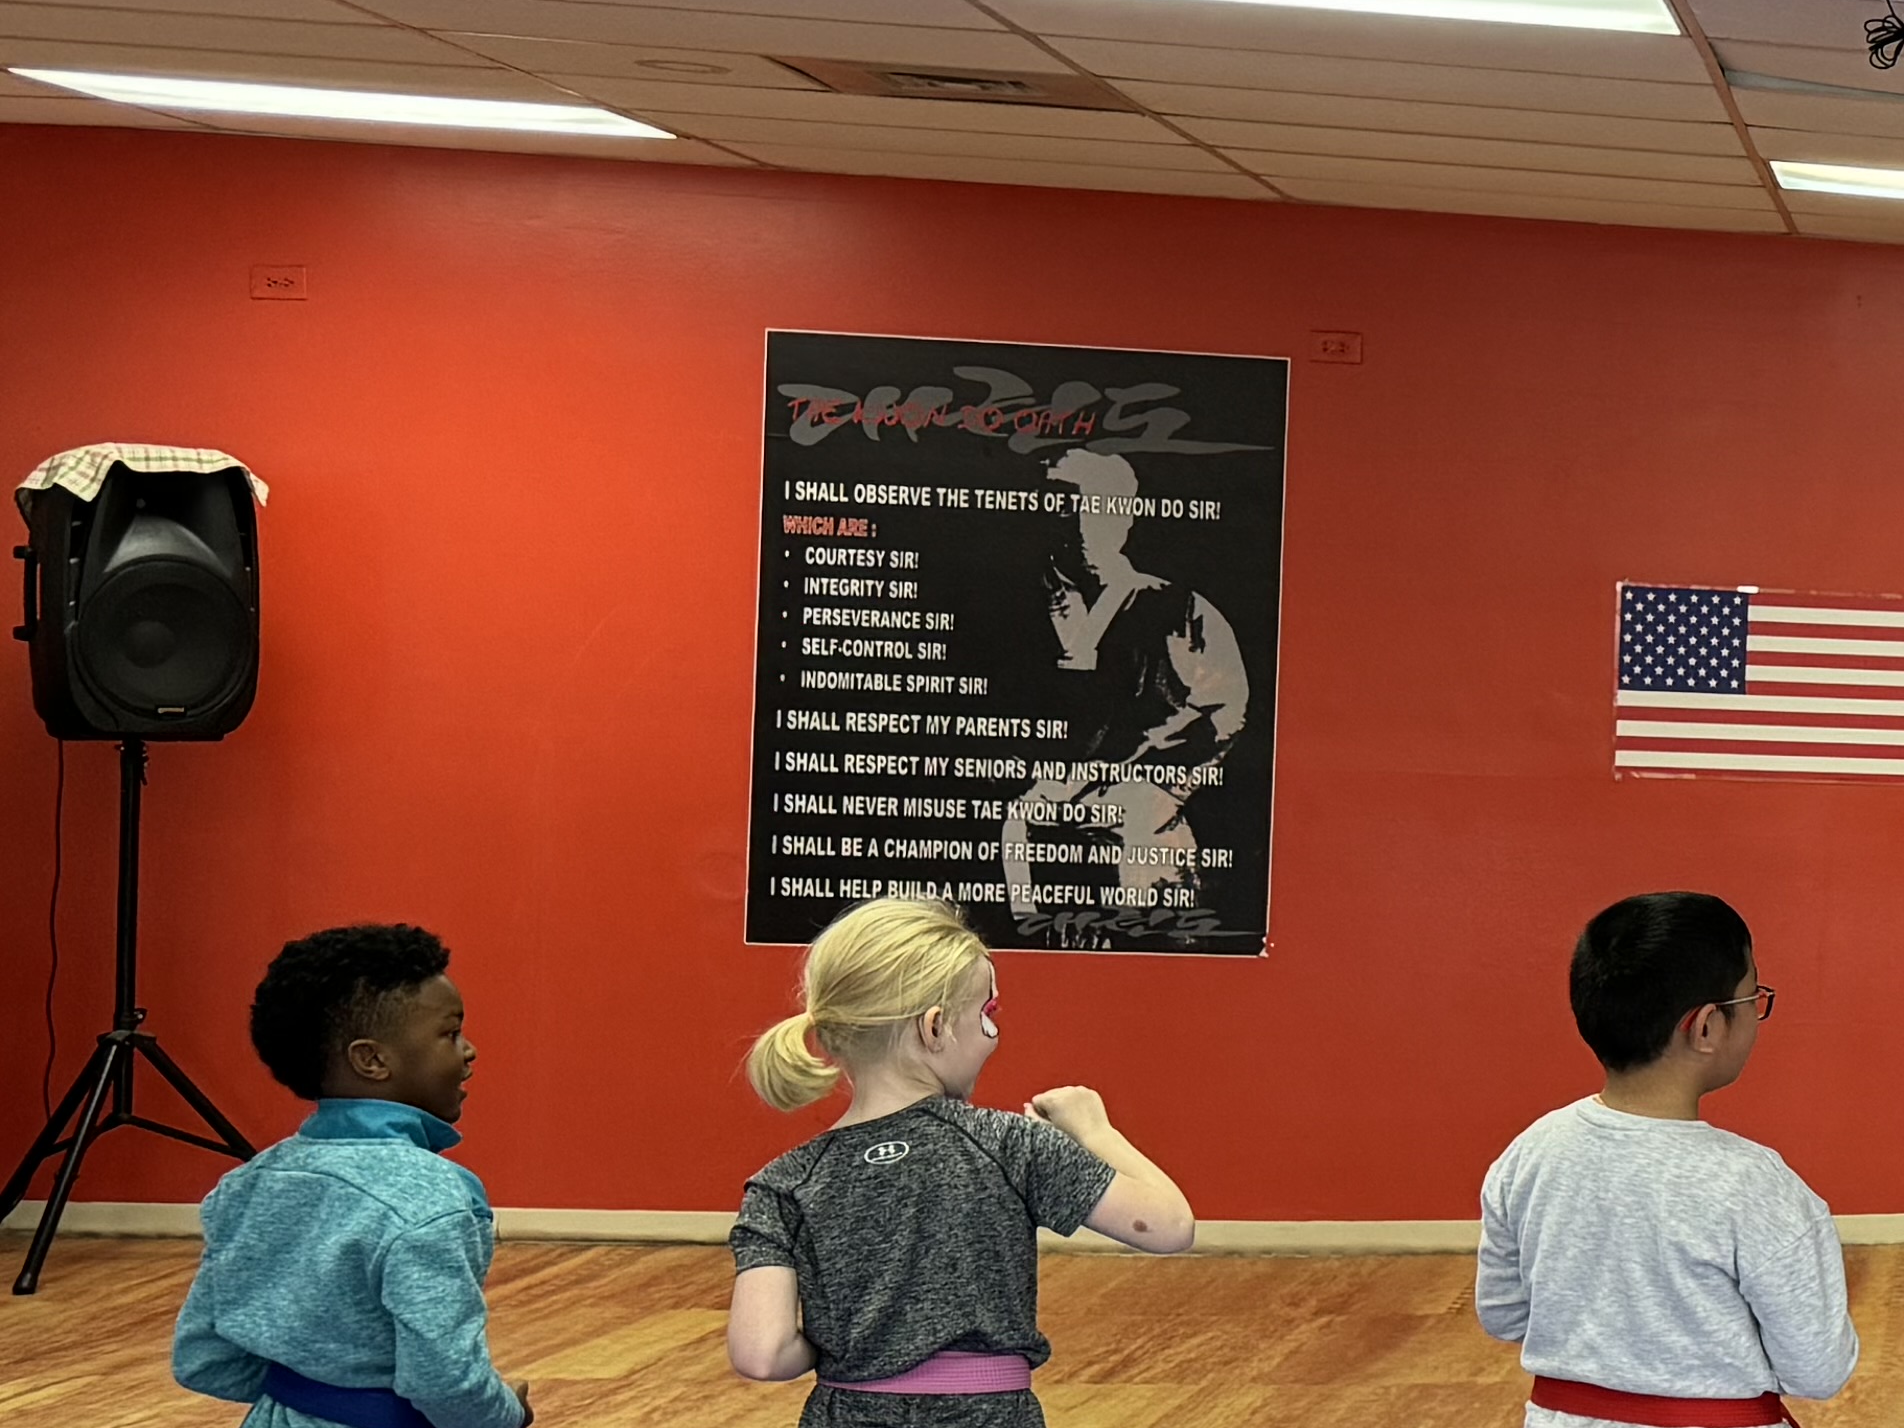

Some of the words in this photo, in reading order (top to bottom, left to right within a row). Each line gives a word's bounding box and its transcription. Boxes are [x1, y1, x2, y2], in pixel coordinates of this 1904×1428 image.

[1013, 408, 1096, 436] OATH
[785, 480, 790, 500] I
[795, 481, 848, 503] SHALL
[854, 483, 931, 506] OBSERVE
[936, 487, 969, 508] THE
[974, 489, 1039, 512] TENETS
[1044, 493, 1065, 513] OF
[1069, 494, 1100, 515] TAE
[1107, 496, 1155, 517] KWON
[1161, 499, 1184, 518] DO
[1188, 500, 1221, 520] SIR!
[783, 514, 834, 536] WHICH
[837, 517, 868, 537] ARE
[805, 546, 885, 568] COURTESY
[889, 551, 919, 569] SIR!
[804, 577, 884, 598] INTEGRITY
[888, 581, 918, 599] SIR!
[803, 606, 921, 630] PERSEVERANCE
[925, 613, 955, 631] SIR!
[801, 637, 913, 659] SELF-CONTROL
[917, 642, 947, 661] SIR!
[800, 670, 902, 692] INDOMITABLE
[906, 675, 955, 694] SPIRIT
[958, 677, 988, 695] SIR!
[776, 709, 781, 729] I
[787, 710, 840, 732] SHALL
[845, 712, 921, 734] RESPECT
[926, 715, 951, 735] MY
[955, 716, 1031, 738] PARENTS
[1035, 719, 1068, 739] SIR!
[775, 751, 780, 771] I
[785, 752, 838, 773] SHALL
[844, 754, 919, 776] RESPECT
[924, 757, 949, 776] MY
[954, 758, 1026, 780] SENIORS
[1031, 760, 1066, 780] AND
[1071, 762, 1187, 784] INSTRUCTORS
[1192, 766, 1223, 786] SIR!
[773, 793, 779, 812] I
[783, 793, 837, 815] SHALL
[842, 796, 898, 817] NEVER
[903, 798, 966, 819] MISUSE
[972, 800, 1002, 820] TAE
[1007, 802, 1057, 821] KWON
[1063, 803, 1085, 822] DO
[1090, 805, 1123, 823] SIR!
[772, 835, 777, 854] I
[782, 835, 835, 856] SHALL
[841, 837, 862, 856] BE
[867, 838, 879, 857] A
[884, 838, 973, 860] CHAMPION
[978, 841, 1000, 860] OF
[1004, 843, 1083, 864] FREEDOM
[1088, 845, 1122, 864] AND
[1127, 847, 1196, 866] JUSTICE
[1201, 849, 1232, 867] SIR!
[770, 876, 776, 896] I
[781, 877, 834, 897] SHALL
[839, 879, 882, 898] HELP
[888, 880, 937, 900] BUILD
[941, 882, 953, 900] A
[958, 883, 1005, 902] MORE
[1011, 884, 1095, 904] PEACEFUL
[1100, 887, 1158, 906] WORLD
[1163, 888, 1195, 907] SIR!
